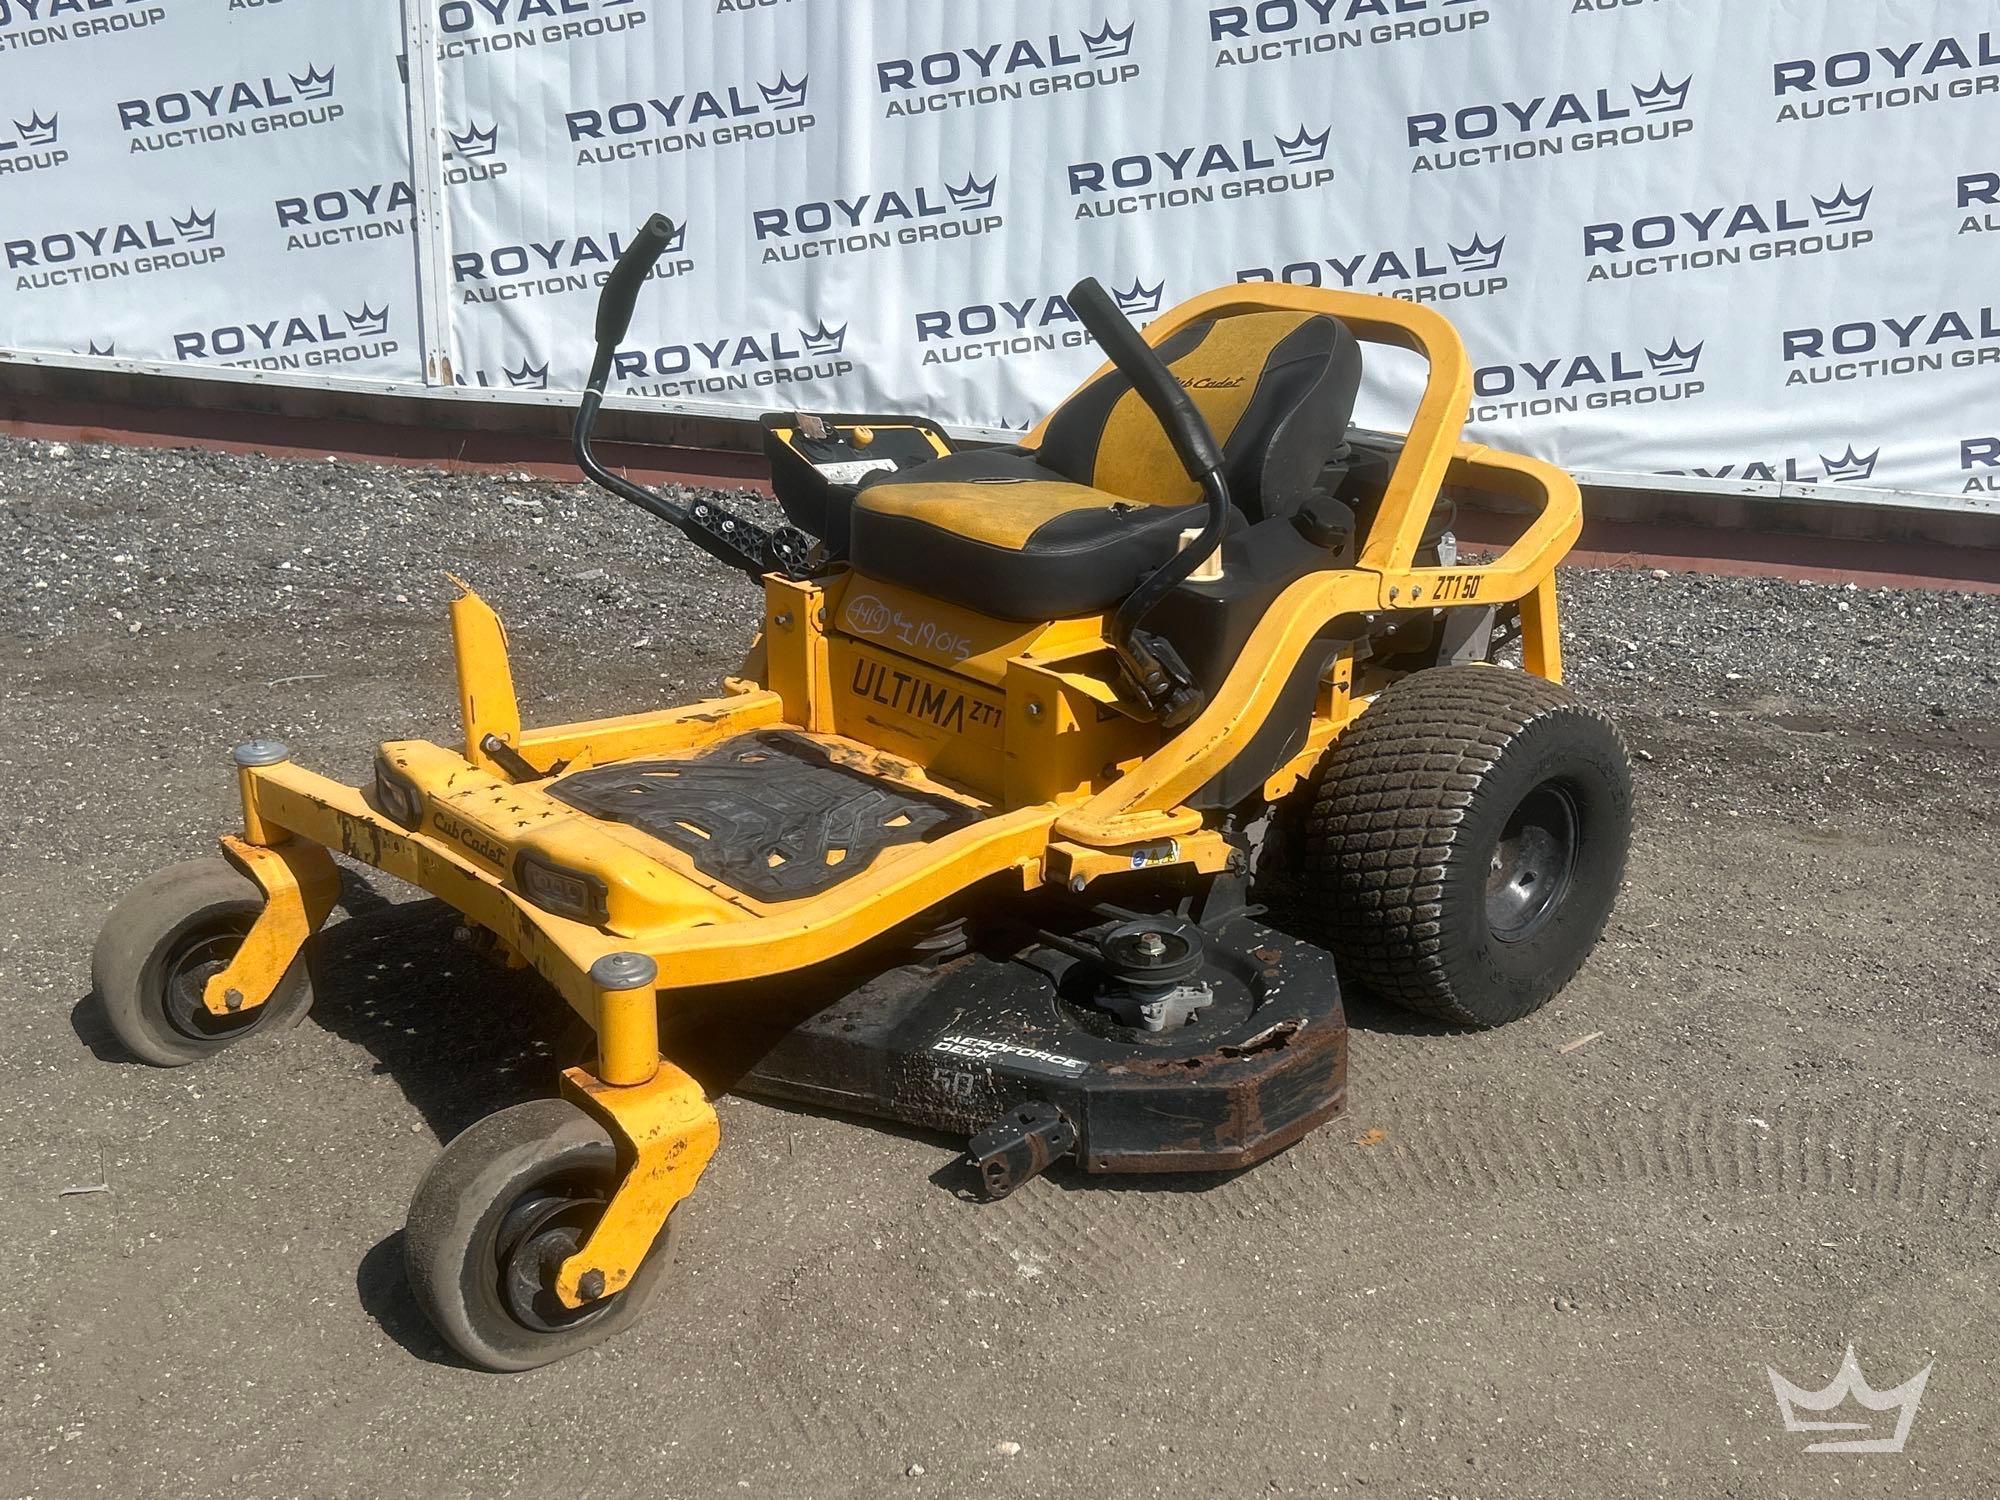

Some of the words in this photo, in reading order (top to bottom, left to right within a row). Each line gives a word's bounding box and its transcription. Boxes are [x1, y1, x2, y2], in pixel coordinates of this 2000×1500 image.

[0, 25, 68, 50] TION
[72, 8, 166, 39] GROUP
[437, 29, 536, 61] CTION
[542, 11, 647, 44] GROUP
[438, 0, 589, 34] OYA
[1215, 29, 1362, 68] AUCTION
[1370, 10, 1490, 44] GROUP
[876, 35, 1081, 93] ROYAL
[1774, 32, 2000, 96] ROYAL
[117, 77, 293, 131] ROYAL
[565, 86, 760, 141] ROYAL
[885, 81, 1022, 118] AUCTION
[1029, 64, 1140, 96] GROUP
[1776, 83, 1940, 123] AUCTION
[129, 120, 247, 154] AUCTION
[251, 104, 344, 134] GROUP
[576, 131, 706, 166] AUCTION
[713, 114, 816, 146] GROUP
[1407, 89, 1630, 147] ROYAL
[0, 150, 69, 175] ROUP
[1067, 139, 1275, 195] ROYAL
[1411, 137, 1563, 173] AUCTION
[1572, 119, 1694, 152] GROUP
[443, 162, 508, 186] OUP
[1074, 186, 1214, 220] AUCTION
[1221, 168, 1335, 200] GROUP
[275, 181, 417, 228] ROYA
[753, 187, 947, 240] ROYAL
[1583, 200, 1809, 256] ROYAL
[4, 220, 174, 269] ROYAL
[286, 219, 405, 251] AUCTION
[452, 232, 628, 283] ROYAL
[761, 230, 892, 264] AUCTION
[897, 216, 1003, 245] GROUP
[1586, 247, 1740, 282] AUCTION
[1749, 230, 1873, 261] GROUP
[15, 260, 129, 290] AUCTION
[135, 246, 226, 273] GROUP
[463, 274, 587, 305] AUCTION
[594, 259, 695, 288] GUP
[173, 314, 347, 361] ROYAL
[915, 295, 1079, 342] ROYA
[1783, 307, 2000, 361] ROYAL
[219, 353, 300, 371] TION
[305, 340, 399, 367] GROUP
[613, 332, 800, 380] ROYAL
[753, 360, 853, 387] GROUP
[922, 334, 1056, 366] AUCTION
[1785, 353, 1942, 387] AUCTION
[1193, 377, 1246, 389] Cadet
[1473, 352, 1644, 397] OYAL
[1464, 396, 1578, 425] CTION
[1586, 380, 1705, 410] GROUP
[1432, 575, 1462, 600] ZT1
[852, 658, 965, 734] ULTIMA
[968, 700, 1003, 729] ZT1
[432, 812, 460, 840] Cub
[460, 828, 506, 868] Cadet
[932, 1041, 997, 1059] DECK
[943, 1035, 1083, 1069] AEROFORCE
